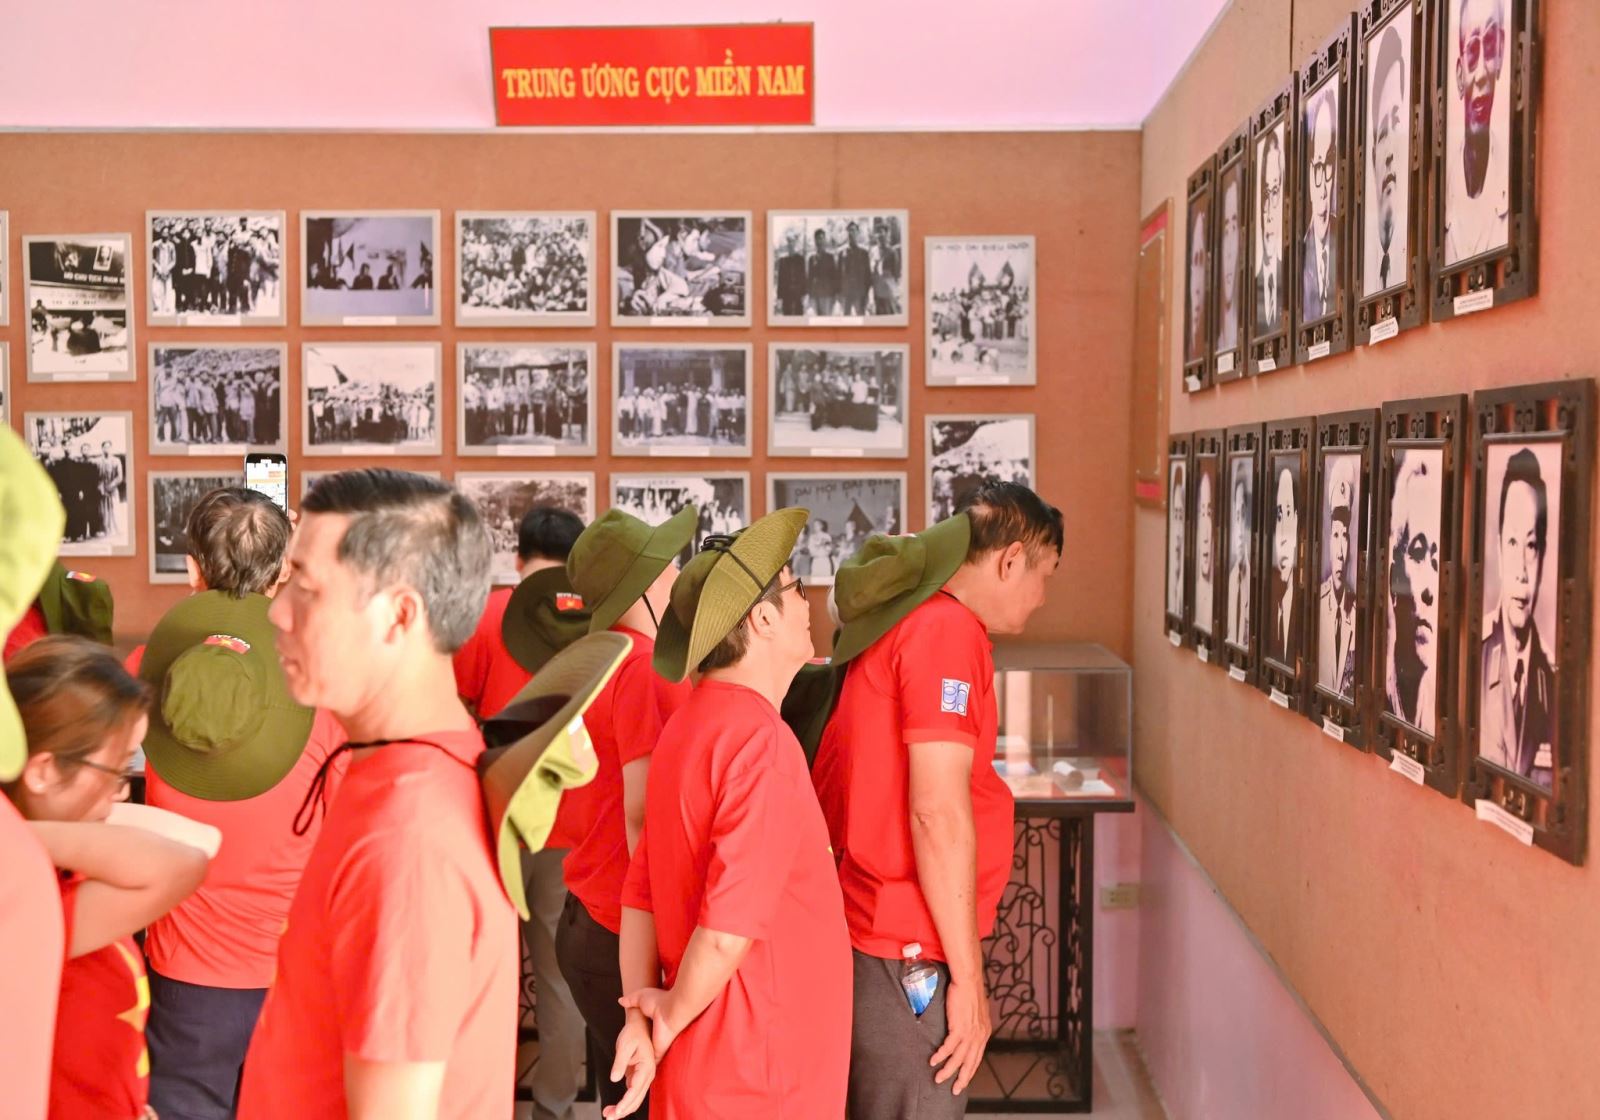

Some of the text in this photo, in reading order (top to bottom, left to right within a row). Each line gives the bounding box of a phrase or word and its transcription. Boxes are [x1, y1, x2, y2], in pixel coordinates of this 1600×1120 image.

[502, 48, 805, 104] TRUNG ƯƠNG CỤC MIỀN NAM
